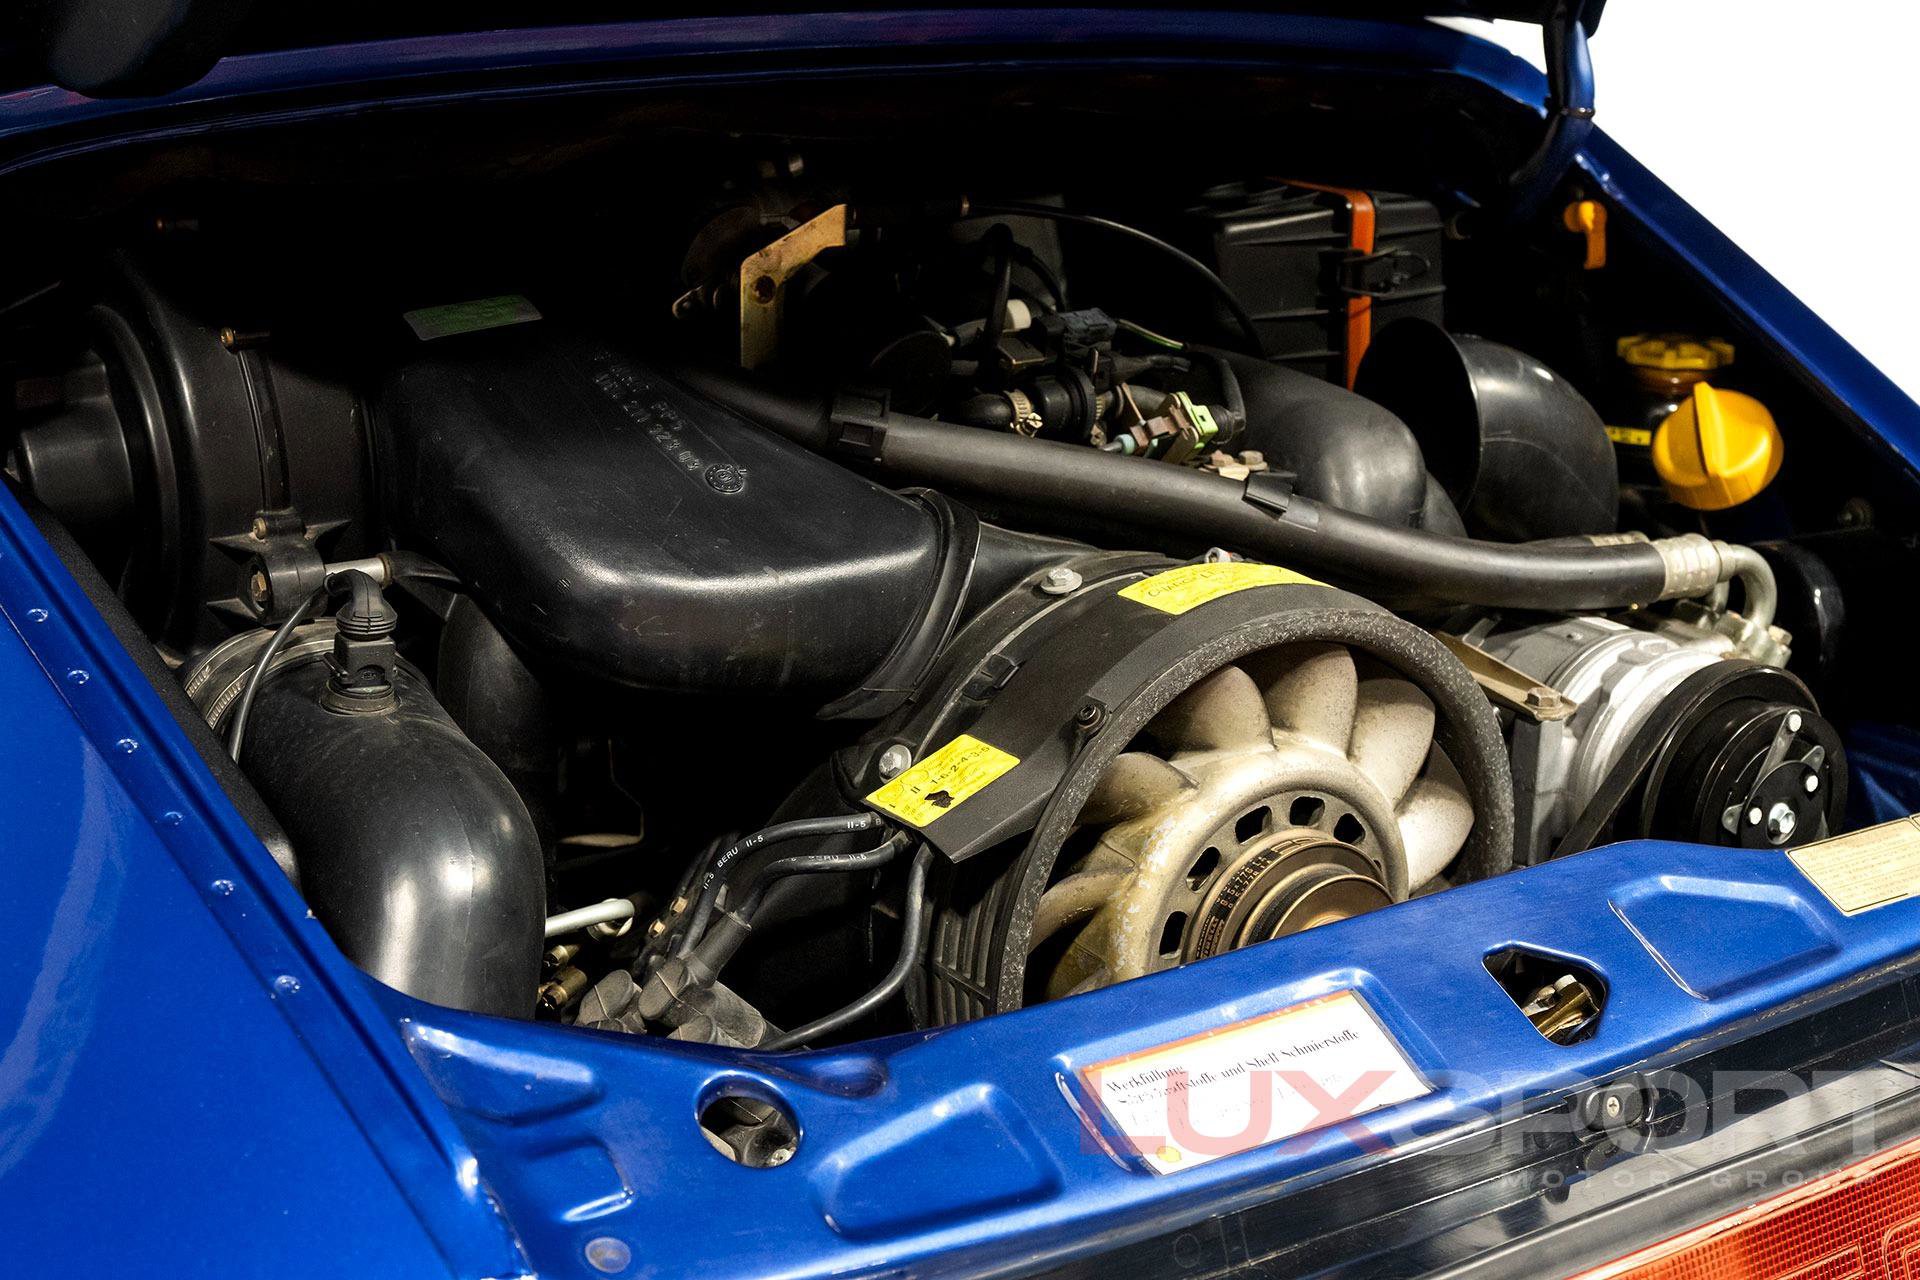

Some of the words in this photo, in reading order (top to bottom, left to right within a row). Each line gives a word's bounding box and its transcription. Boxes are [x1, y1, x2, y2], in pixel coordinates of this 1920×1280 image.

[715, 846, 740, 869] BERU
[745, 834, 764, 848] II-5
[1220, 1062, 1246, 1079] und
[1245, 1051, 1280, 1069] Shell
[1280, 1028, 1360, 1059] Schmierstoffe
[1105, 1064, 1187, 1093] Werkfüllung
